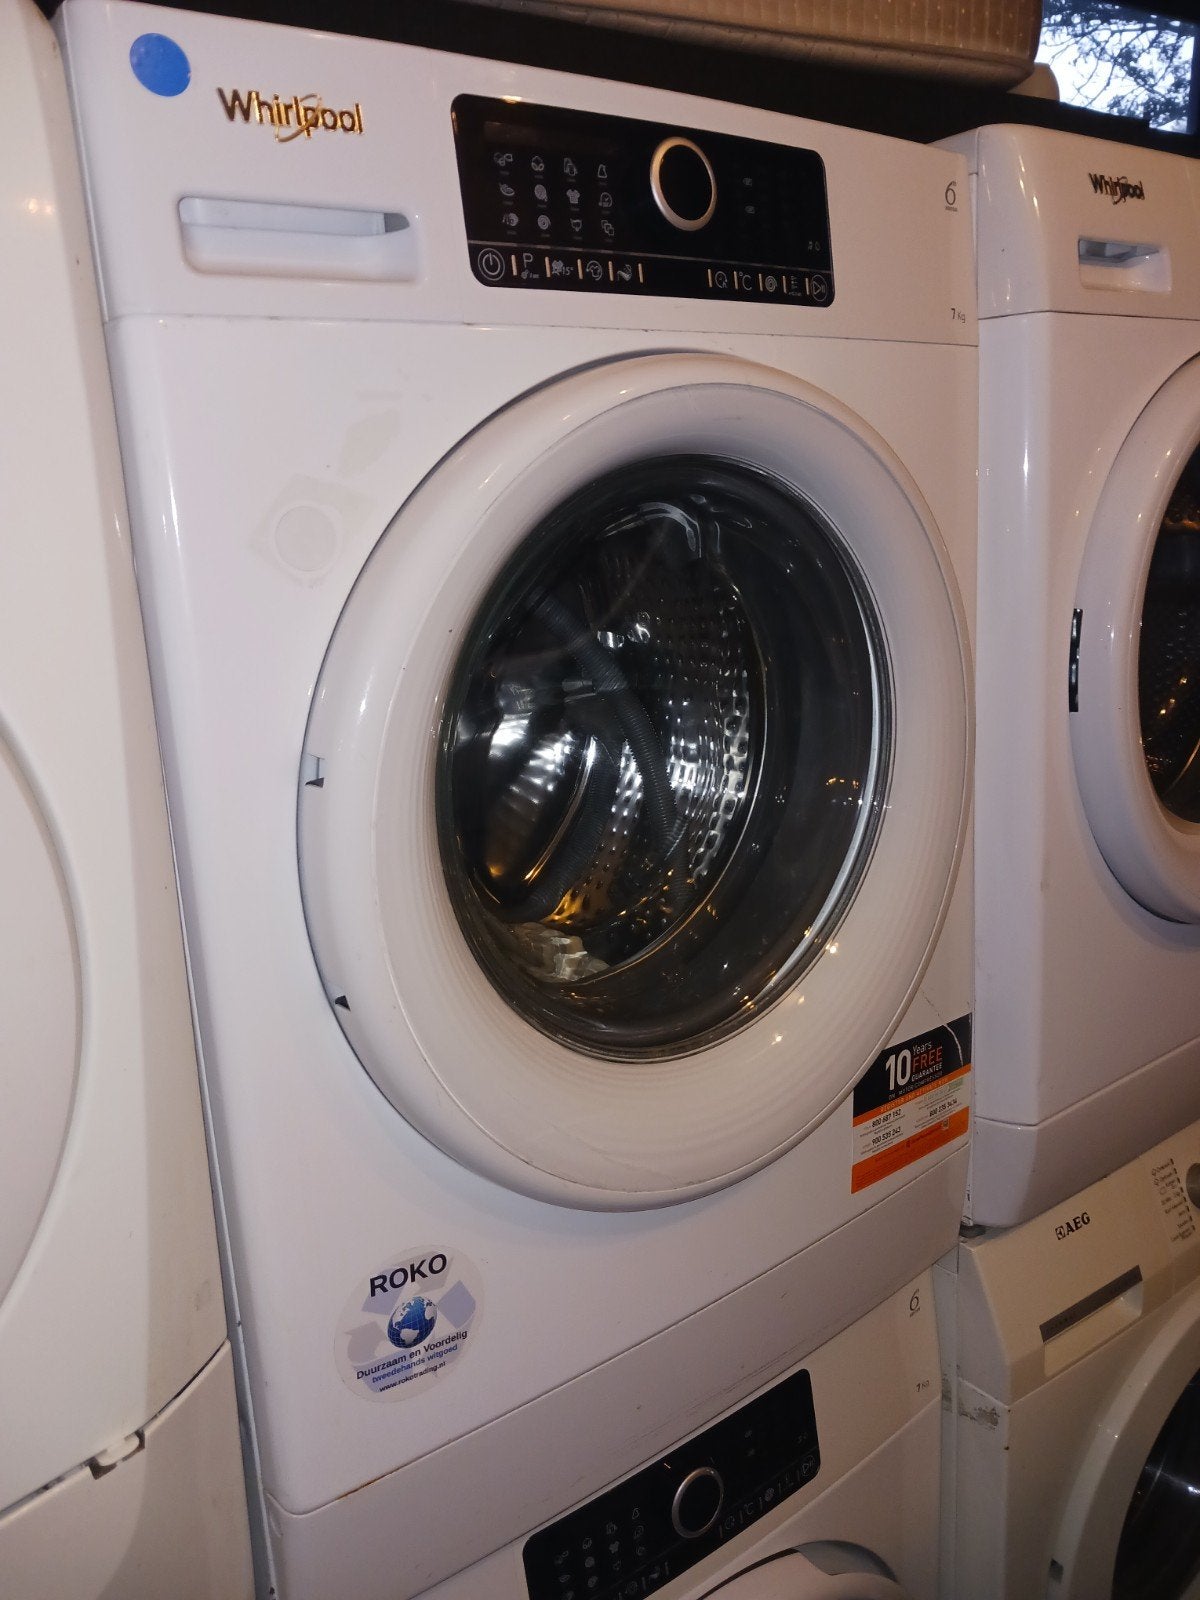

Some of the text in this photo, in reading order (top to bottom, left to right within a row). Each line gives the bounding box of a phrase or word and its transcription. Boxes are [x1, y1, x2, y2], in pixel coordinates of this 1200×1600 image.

[216, 86, 364, 142] Whirlpool
[1088, 172, 1145, 205] Whirlpool
[523, 253, 533, 268] P
[950, 307, 956, 320] 7
[912, 1041, 932, 1055] Years
[912, 1047, 943, 1073] FREE
[885, 1049, 912, 1091] 10
[911, 1062, 943, 1081] GUARANTEE
[1066, 1212, 1091, 1238] AEG
[369, 1253, 448, 1298] ROKO
[356, 1330, 468, 1380] Duurzaam en Voordelig
[372, 1344, 458, 1383] tweedehands witgoed
